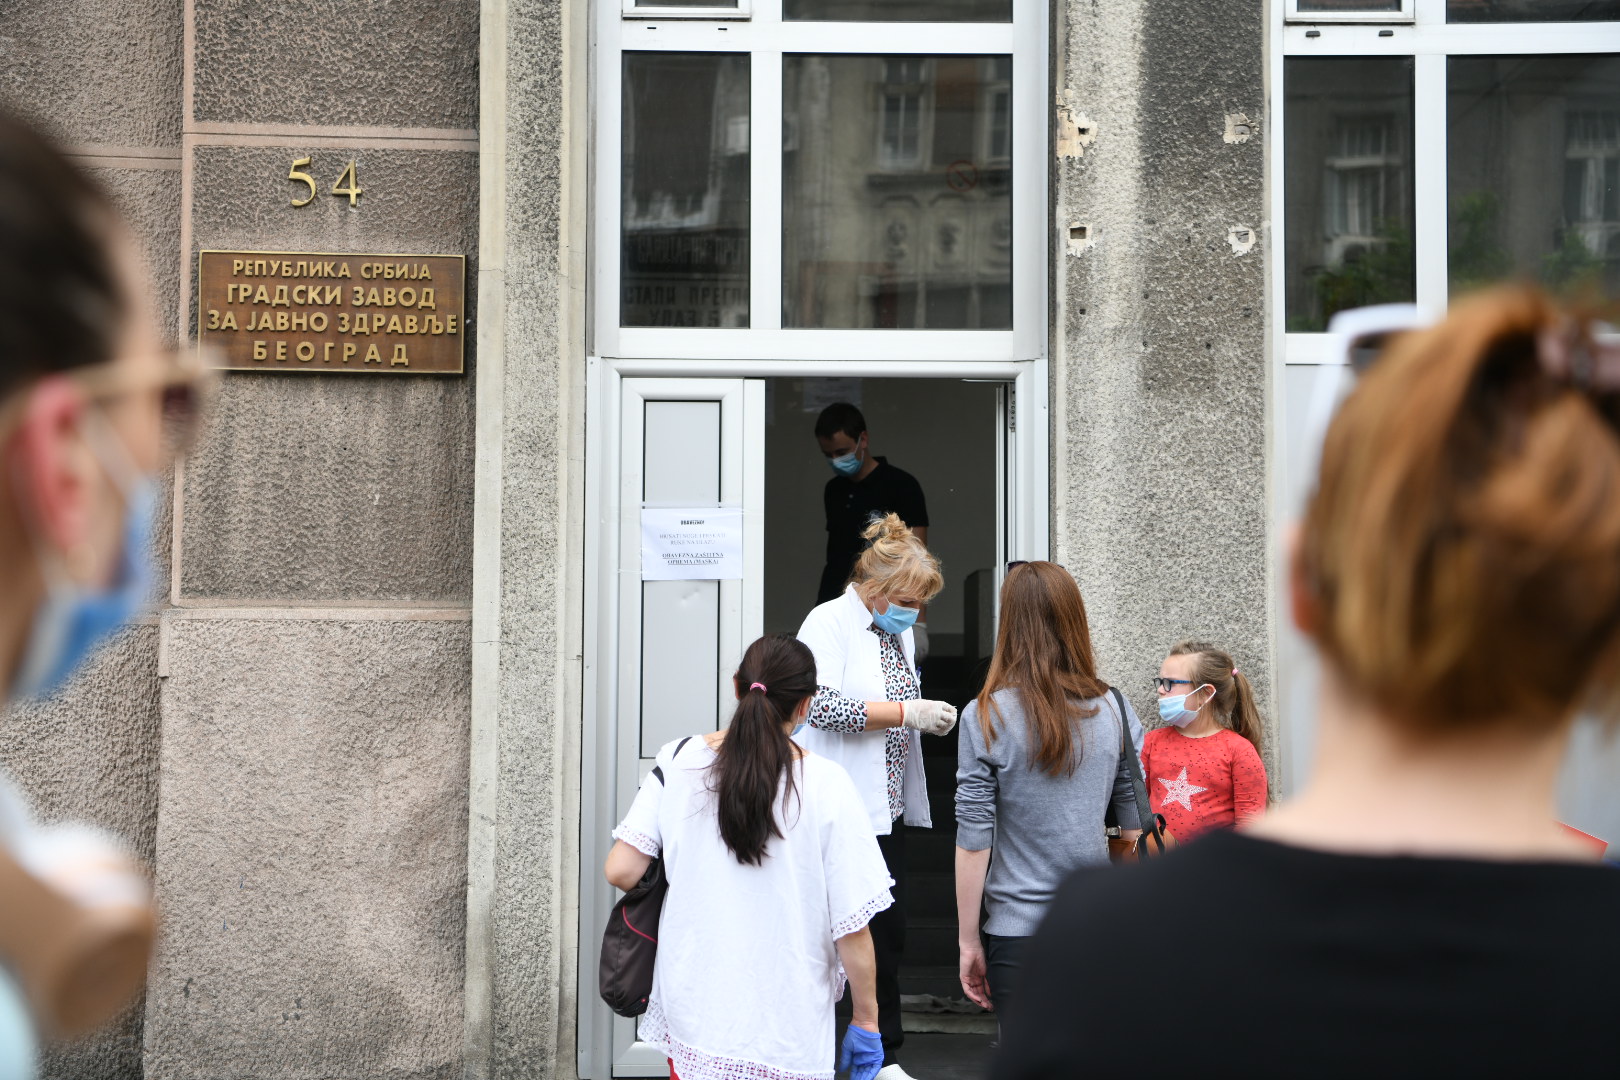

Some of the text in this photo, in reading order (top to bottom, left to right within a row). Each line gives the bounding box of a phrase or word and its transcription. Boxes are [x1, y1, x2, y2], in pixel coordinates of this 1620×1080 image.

[288, 156, 362, 208] 54
[233, 259, 433, 280] РЕПУБЛИКА СРБИЈА
[227, 284, 436, 310] ГРАДСКИ ЗАВОД
[206, 309, 457, 336] ЗА ЈАВНО ЗДРАВЉЕ
[253, 340, 409, 367] БЕОГРАД
